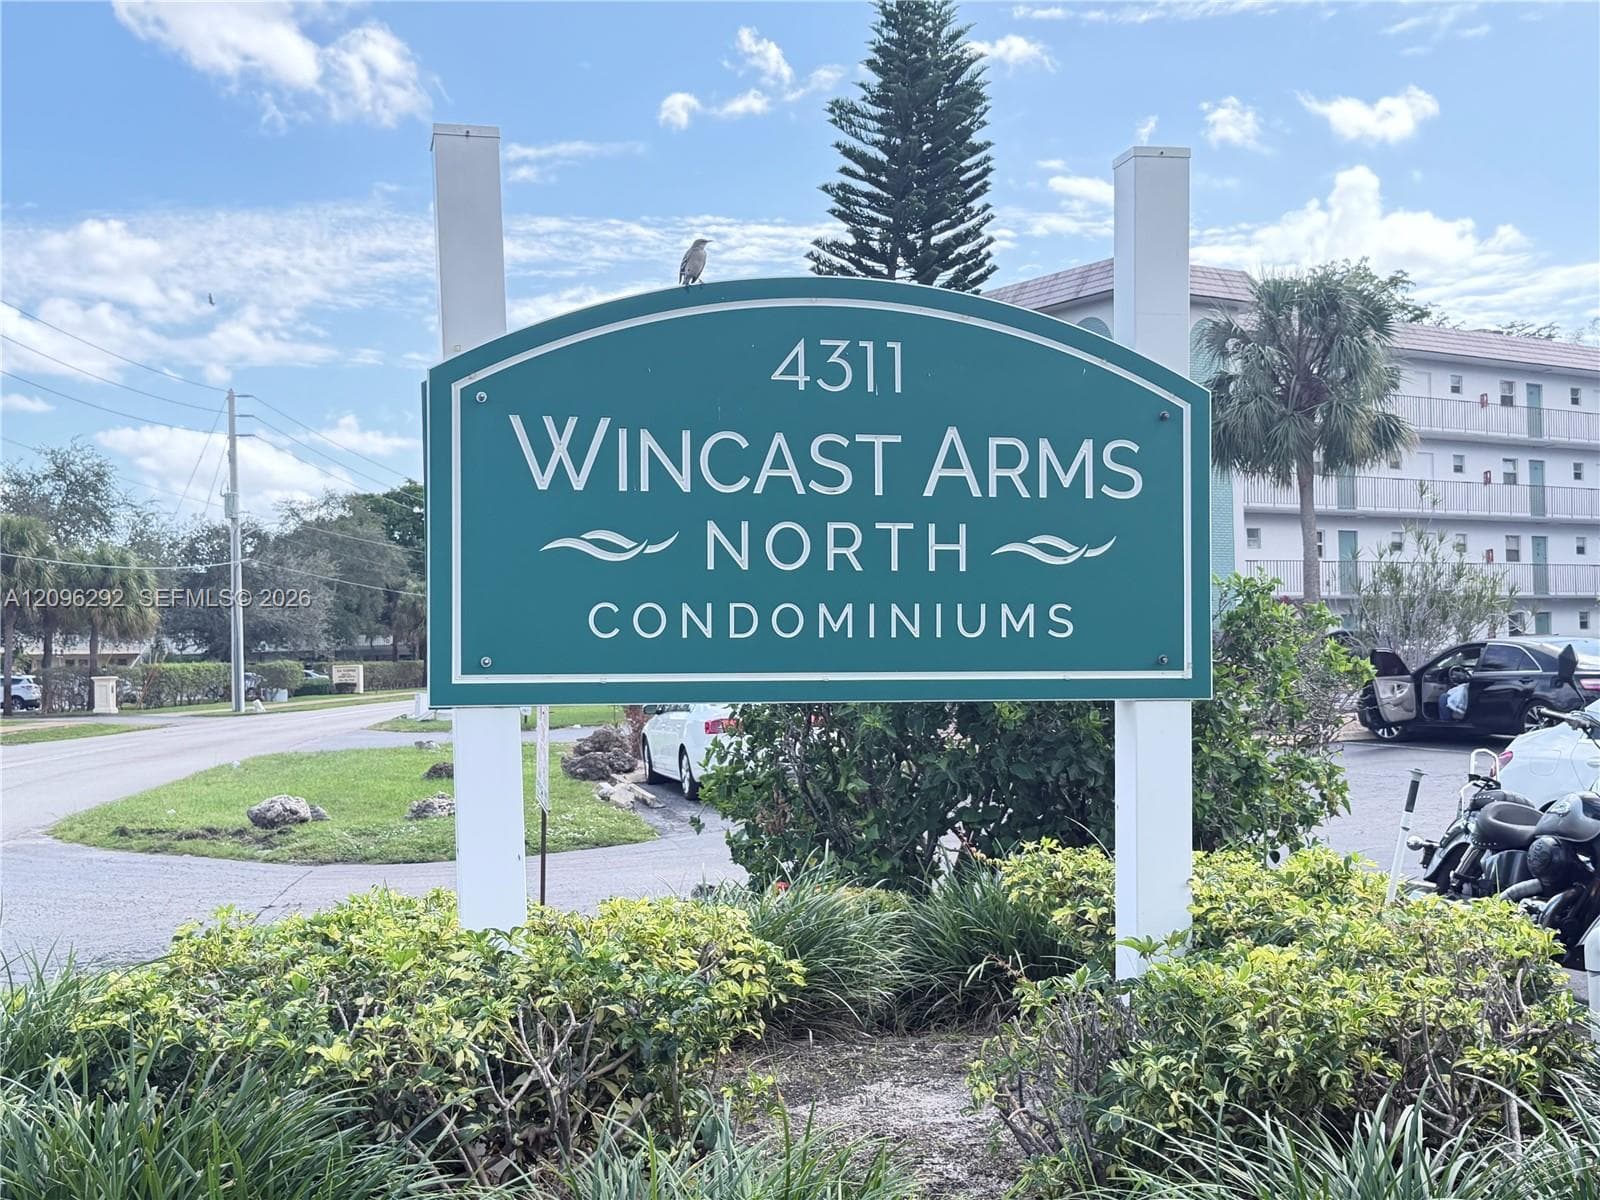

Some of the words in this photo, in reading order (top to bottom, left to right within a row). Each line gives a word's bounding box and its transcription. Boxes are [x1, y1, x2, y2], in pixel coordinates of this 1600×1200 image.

[770, 338, 903, 393] 4311
[706, 520, 967, 572] NORTH
[588, 602, 1074, 639] CONDOMINIUMS
